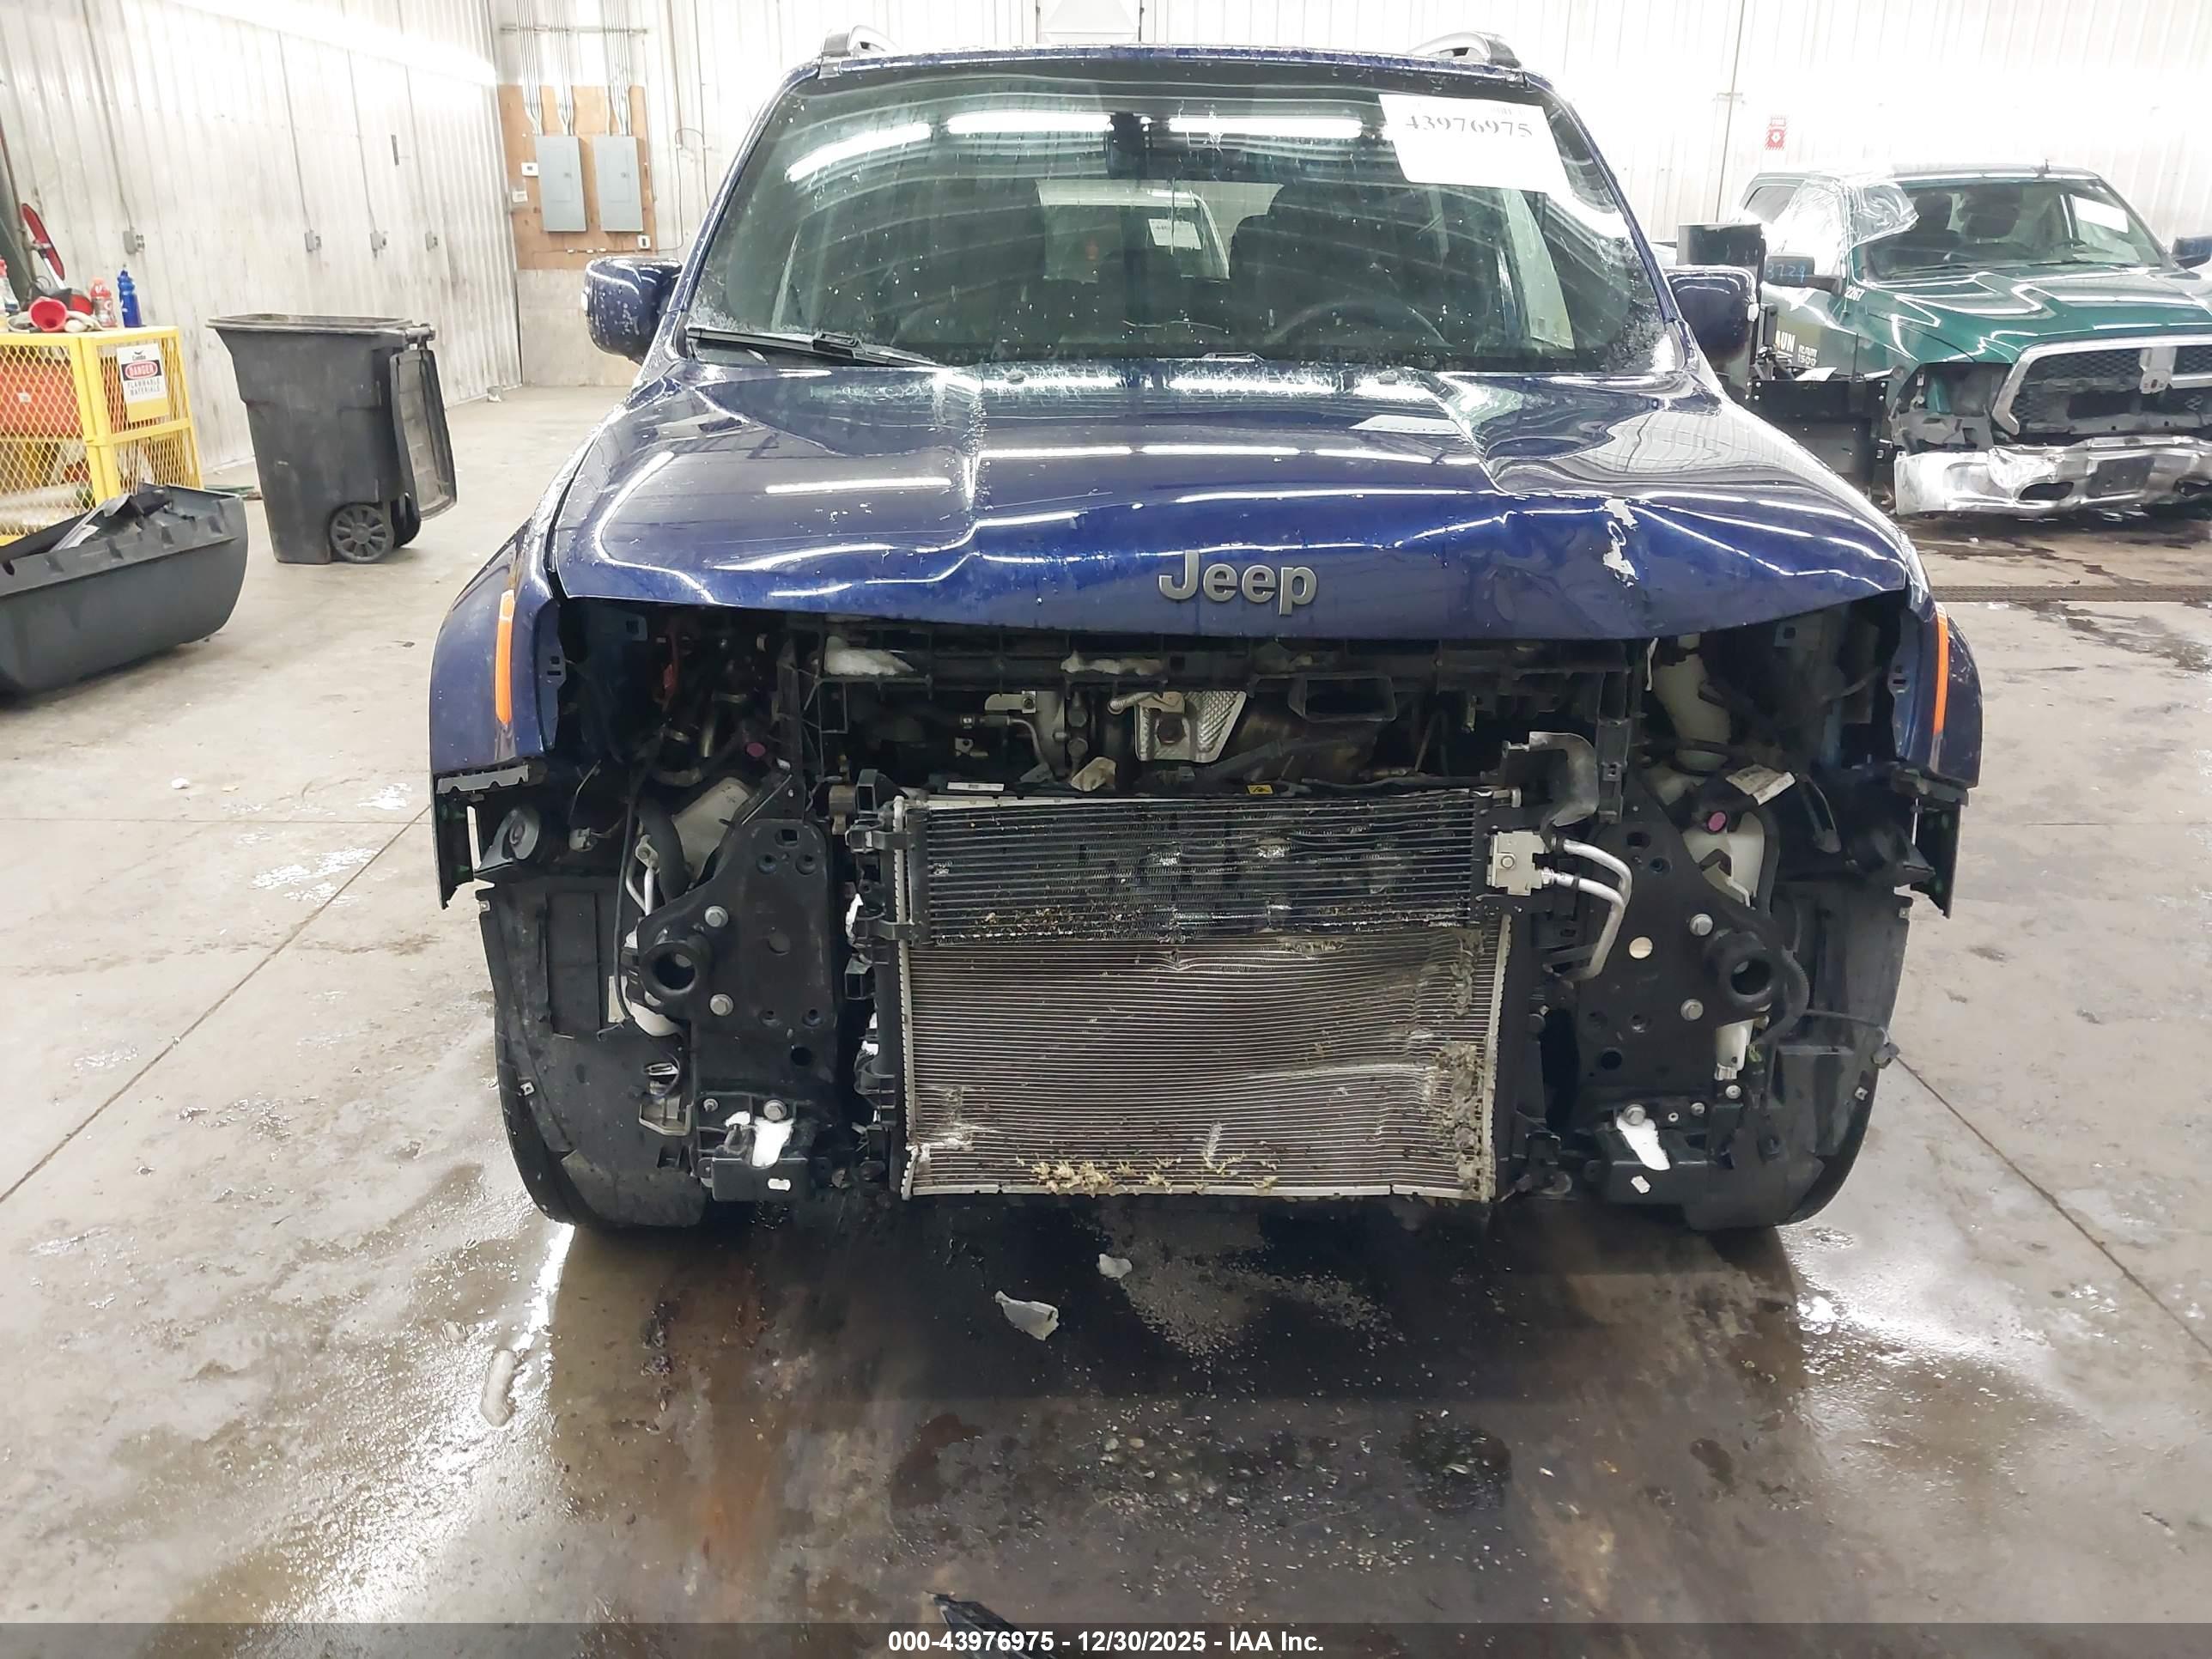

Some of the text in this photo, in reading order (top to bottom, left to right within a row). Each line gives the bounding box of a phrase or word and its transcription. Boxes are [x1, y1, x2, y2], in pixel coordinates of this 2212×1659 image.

[1406, 114, 1533, 137] 43976975
[1798, 344, 1818, 357] RAM
[1797, 353, 1817, 367] 1500
[129, 363, 154, 377] DANGER
[1158, 550, 1317, 617] Jeep
